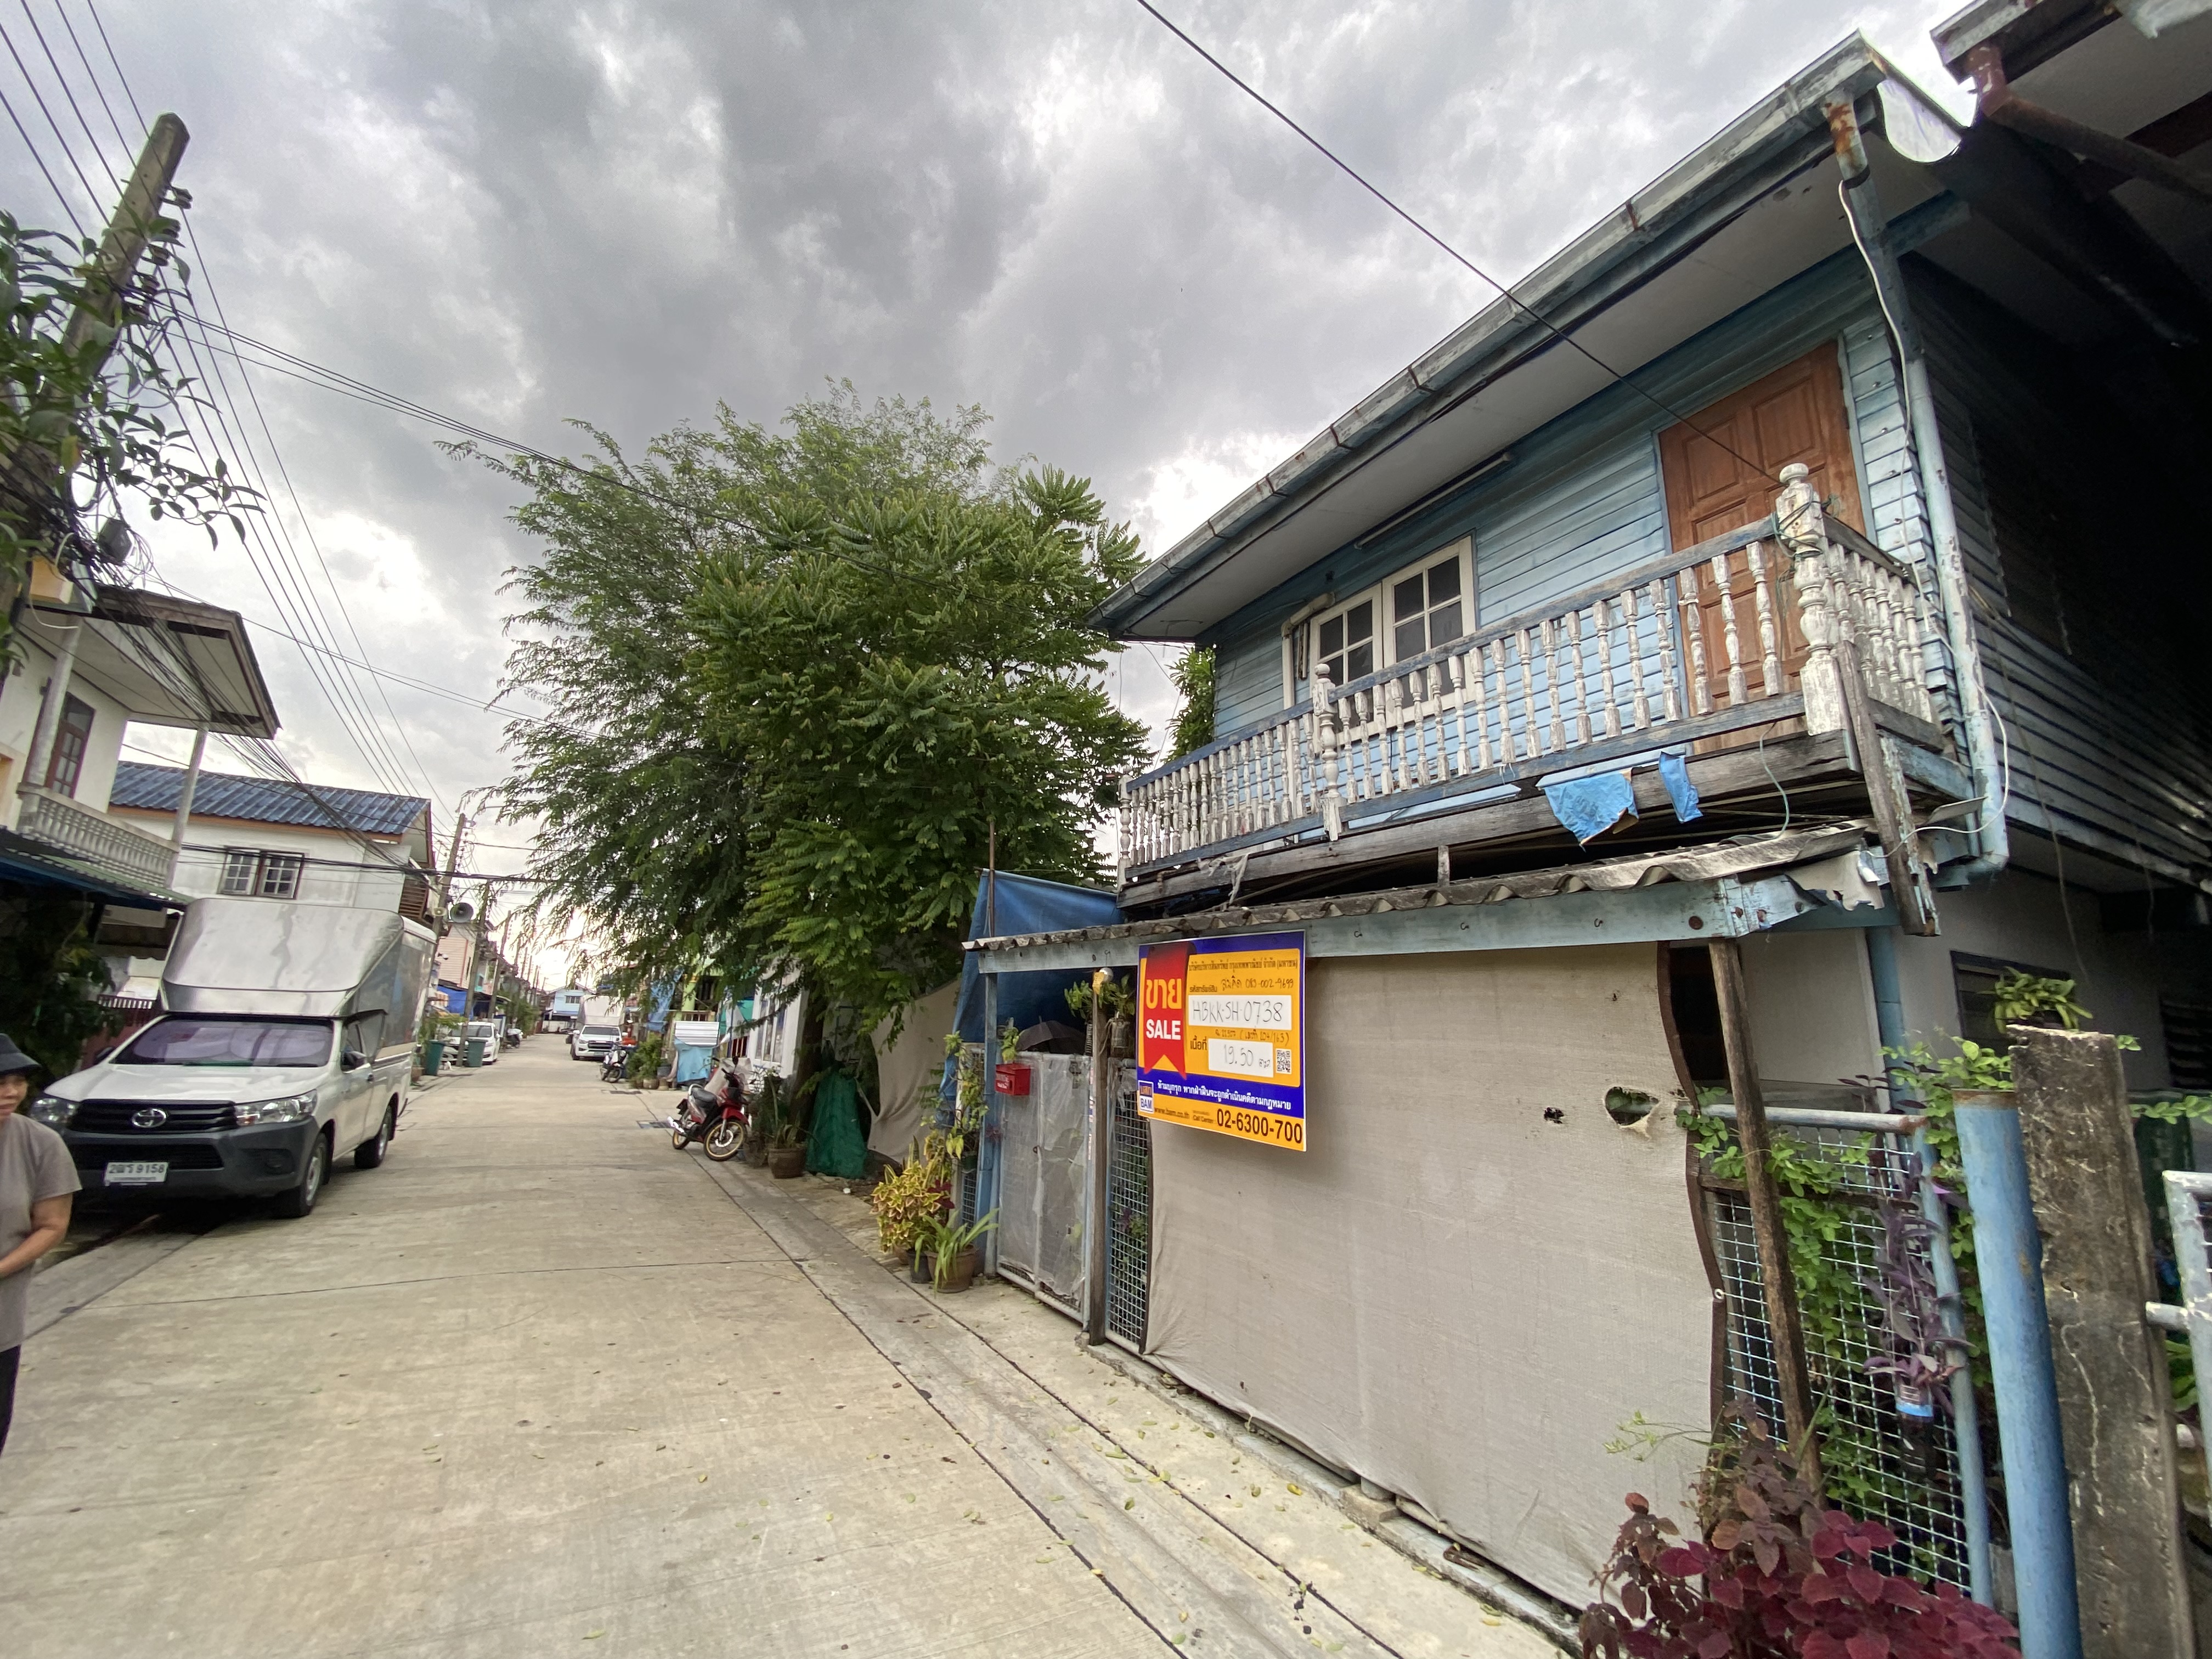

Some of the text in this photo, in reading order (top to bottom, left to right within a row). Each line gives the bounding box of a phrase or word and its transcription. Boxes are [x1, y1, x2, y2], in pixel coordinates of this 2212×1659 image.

[1146, 978, 1182, 1009] ขาย
[1146, 1019, 1181, 1040] SALE
[1190, 1035, 1207, 1051] เนื้อที่
[1223, 1044, 1254, 1066] 19.50
[1157, 1079, 1182, 1096] ห้ามบุกรุก
[1141, 1098, 1152, 1109] BAM
[1217, 1108, 1302, 1144] 02-6300-700
